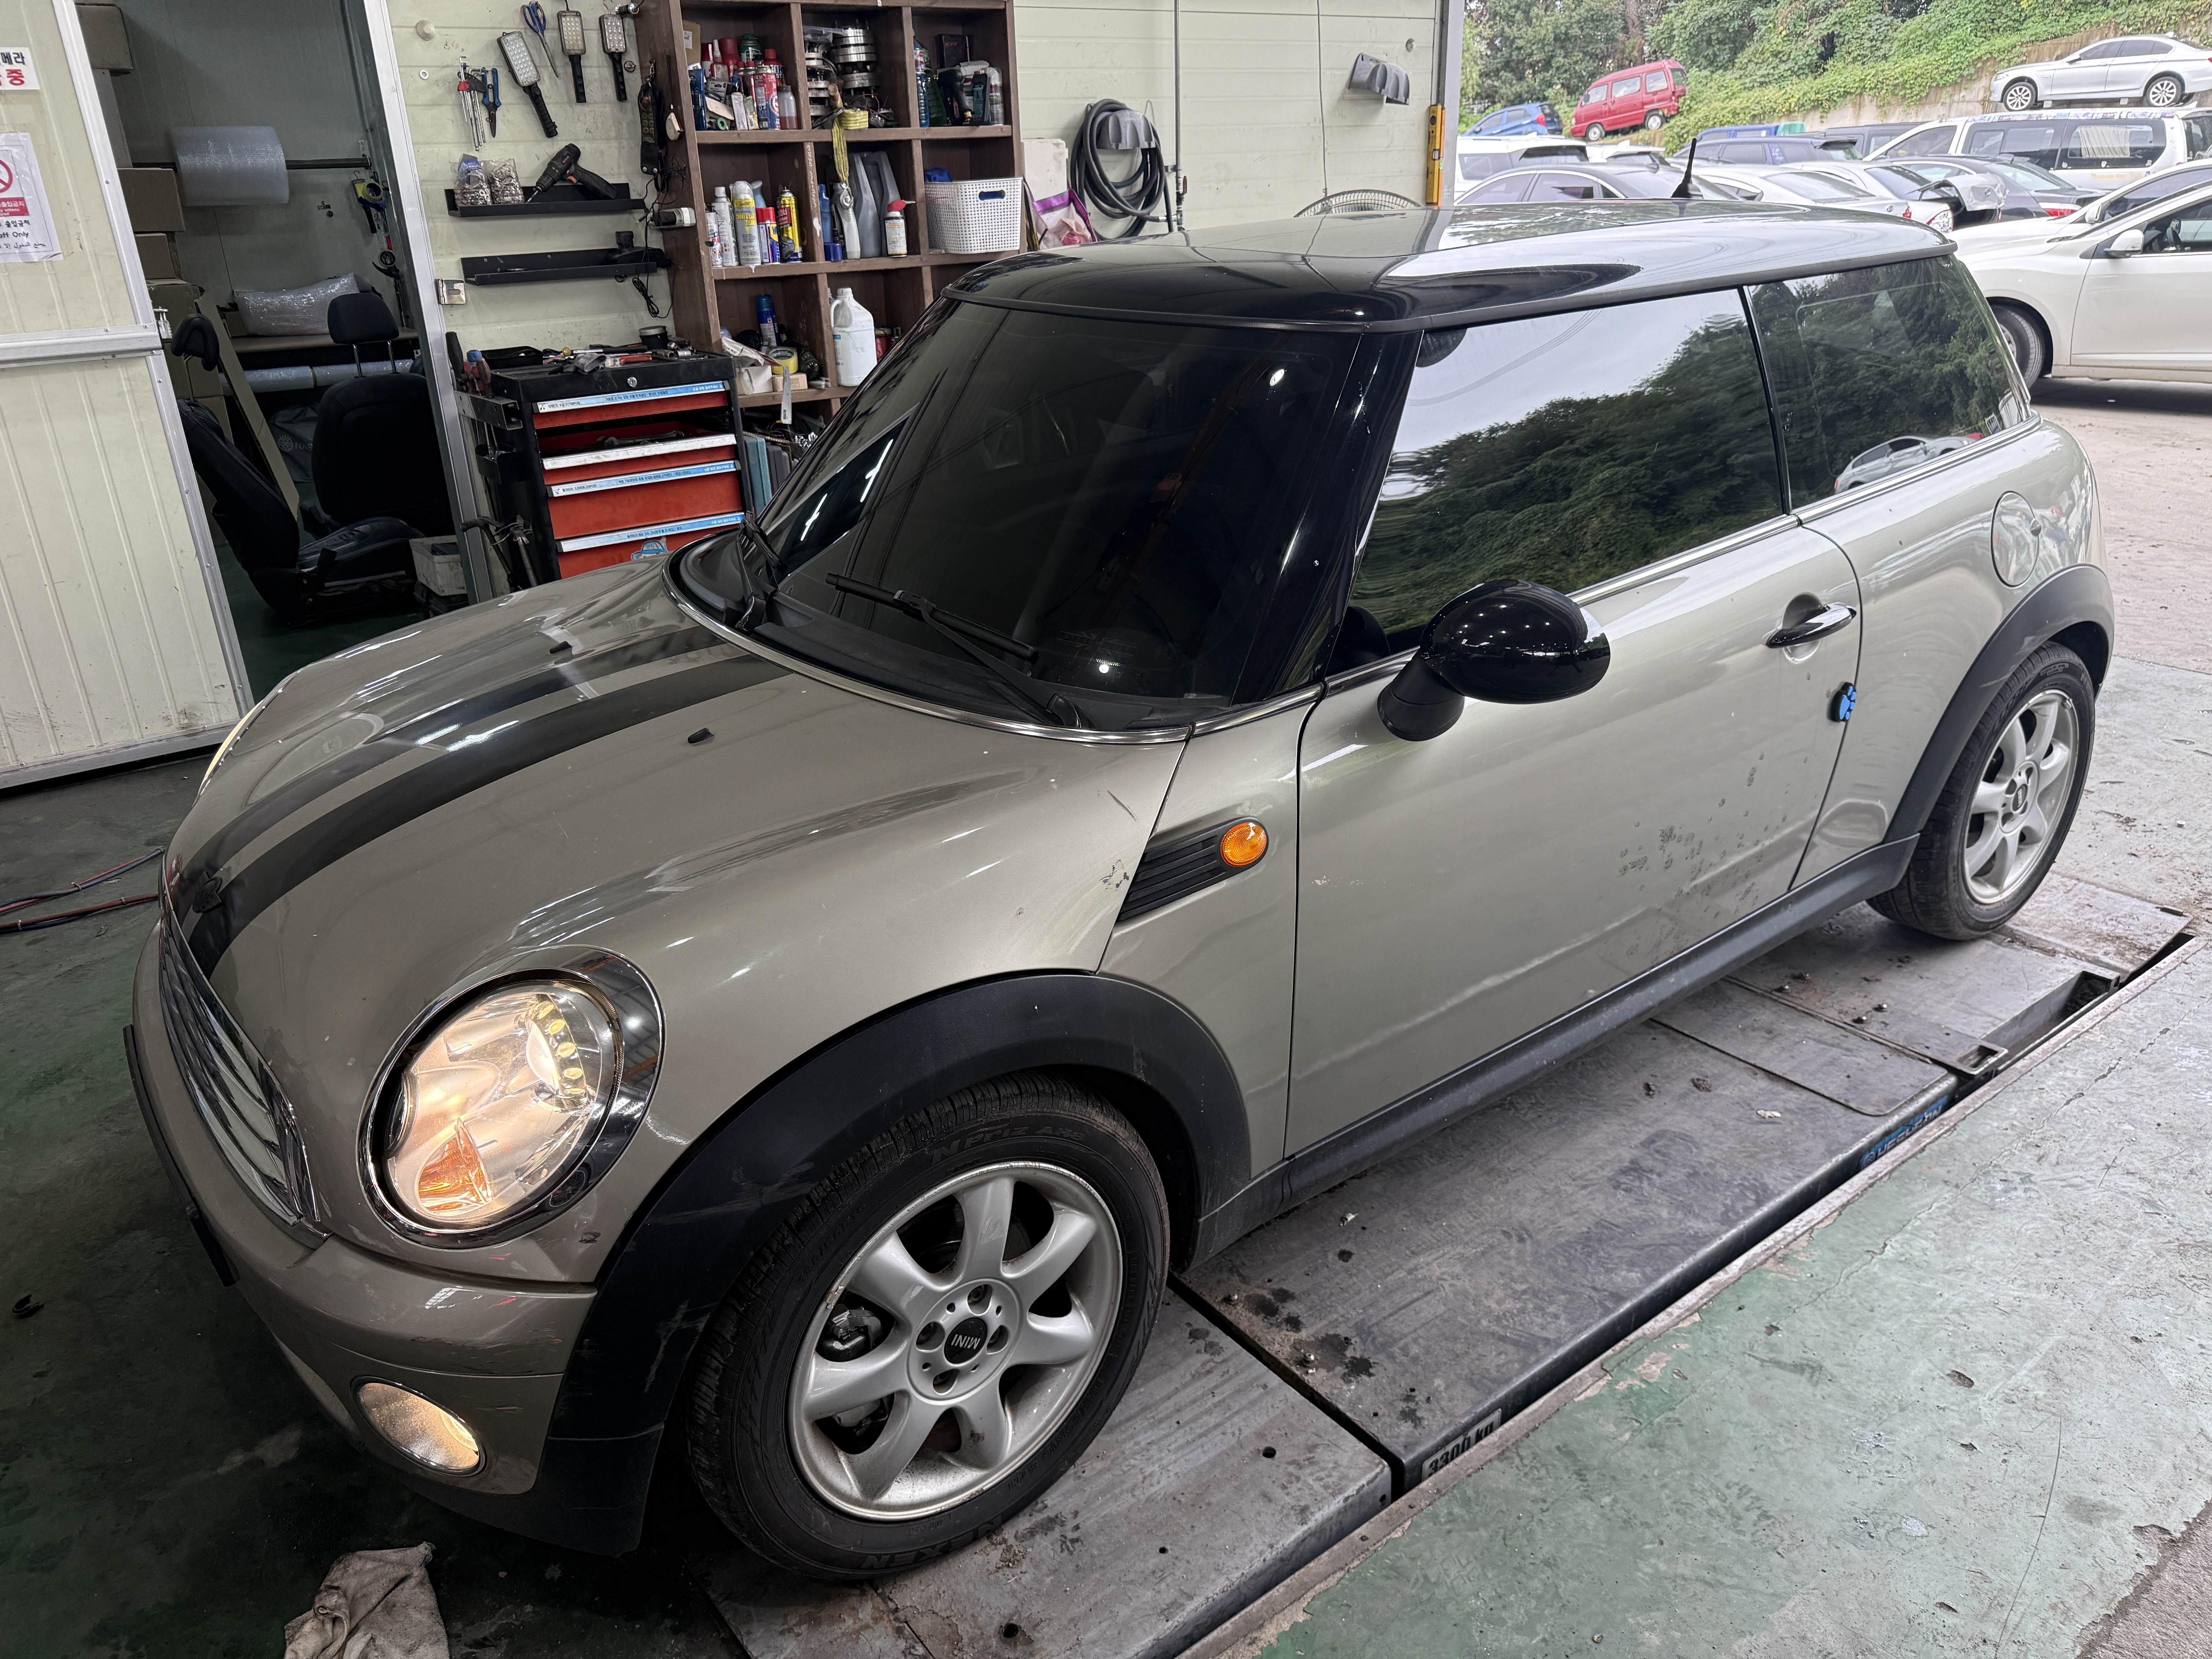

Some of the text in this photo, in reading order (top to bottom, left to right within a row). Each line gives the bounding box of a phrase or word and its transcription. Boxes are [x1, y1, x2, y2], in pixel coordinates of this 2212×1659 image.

[0, 52, 25, 65] 메라
[5, 220, 30, 228] 출입금지
[951, 1334, 981, 1349] MINI
